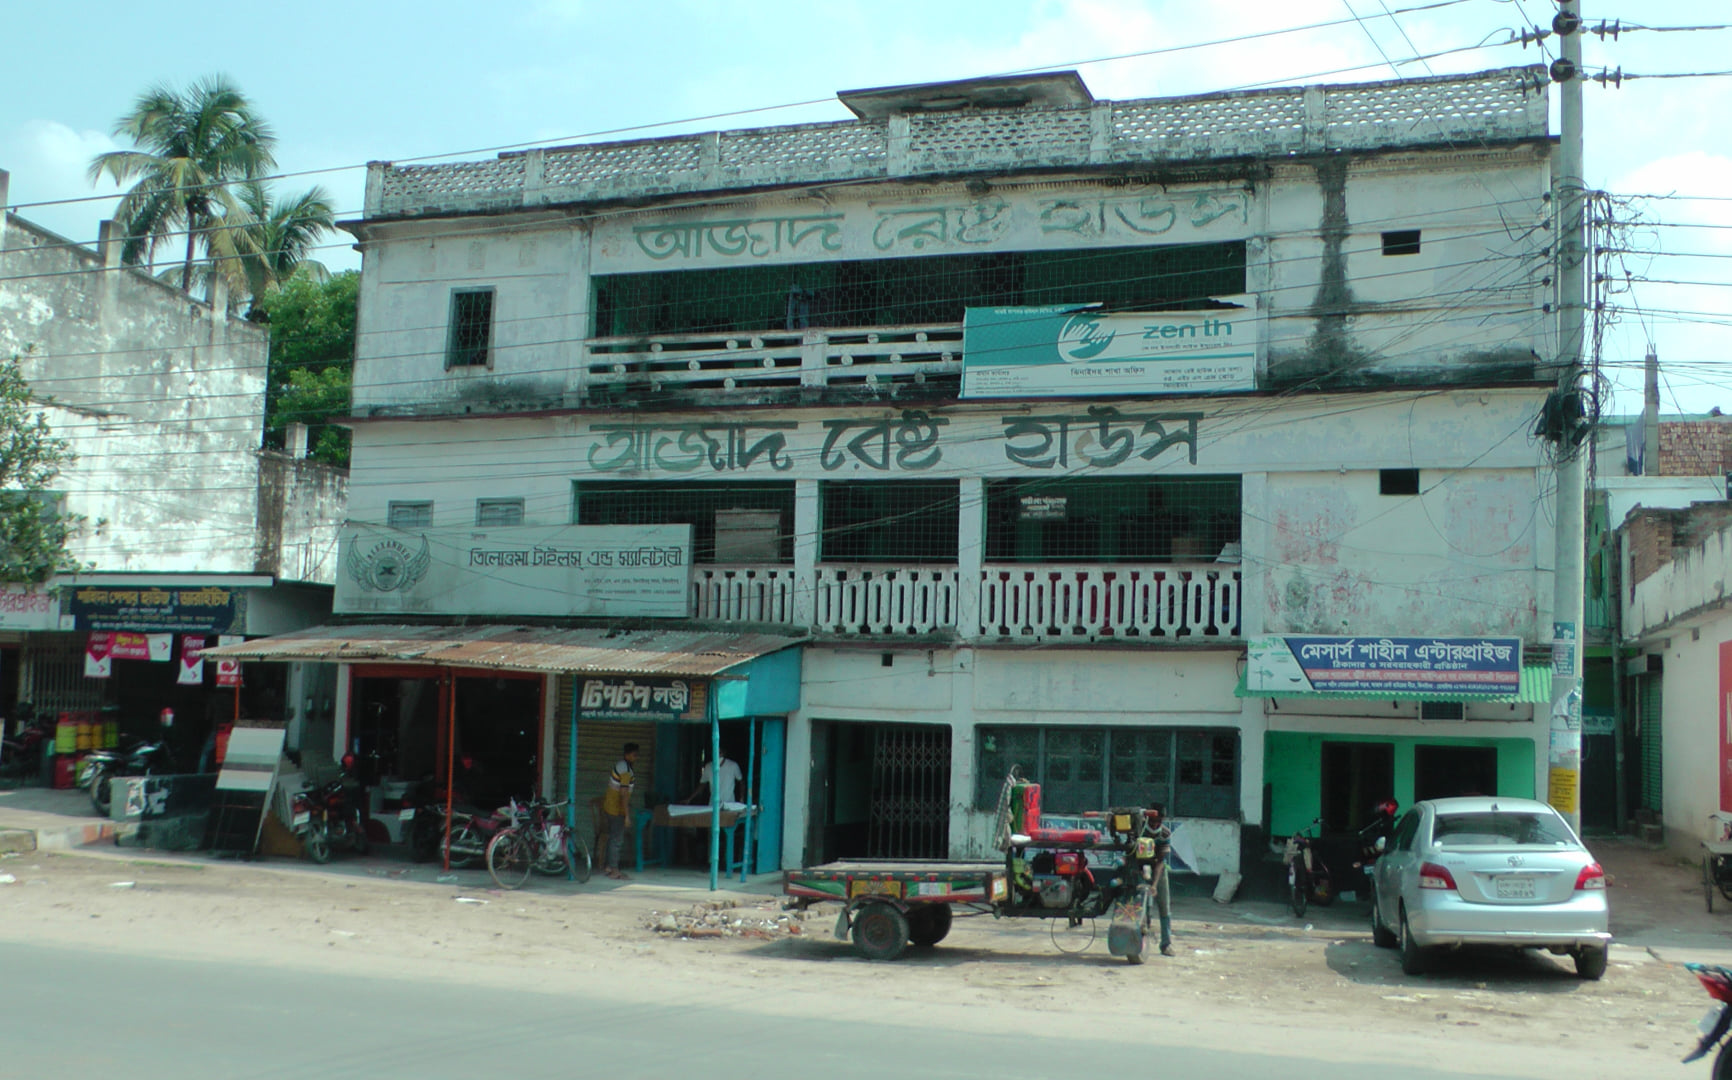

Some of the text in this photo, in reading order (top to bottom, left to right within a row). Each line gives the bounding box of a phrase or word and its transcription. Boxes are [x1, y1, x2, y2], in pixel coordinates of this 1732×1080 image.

[634, 212, 845, 260] আজাদ
[1040, 188, 1253, 237] হাউস
[1071, 365, 1145, 377] ঝিনাইদহ শাখা অফিস
[588, 419, 798, 473] আজাদ
[1003, 405, 1205, 469] হাউস
[469, 546, 530, 568] তিলোত্তমা
[587, 550, 614, 567] এন্ড
[619, 546, 684, 568] স্যানিটারী
[1301, 638, 1513, 663] মেসার্স শাহীন এন্টারপ্রাইজ
[1332, 660, 1366, 669] ঠিকাদার
[1379, 660, 1431, 669] সরবরাহকারী
[1433, 661, 1468, 670] প্রতিষ্ঠান
[580, 679, 651, 710] টিপটপ
[652, 679, 689, 711] লন্ড্রী
